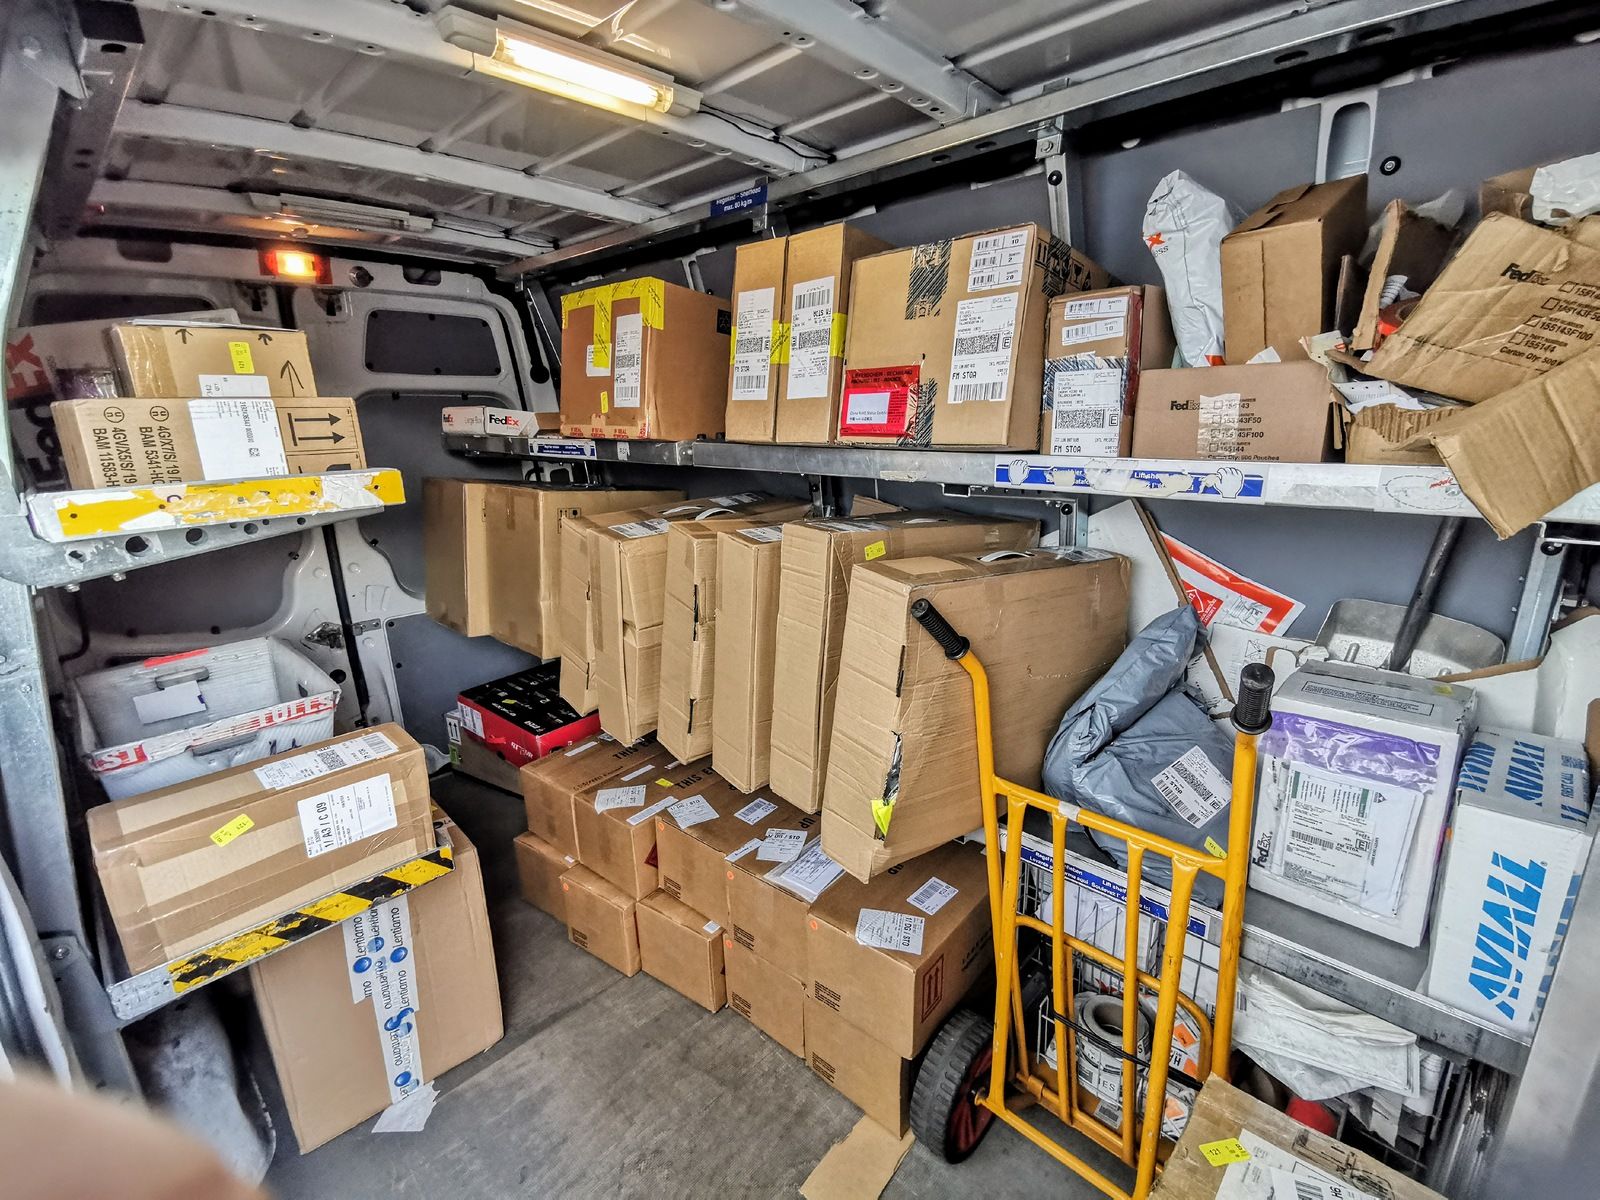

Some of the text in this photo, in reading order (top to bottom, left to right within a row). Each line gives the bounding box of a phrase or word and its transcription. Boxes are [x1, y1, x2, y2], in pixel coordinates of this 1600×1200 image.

[1501, 262, 1550, 286] FedEx
[952, 371, 977, 380] FM STOA
[489, 414, 519, 426] FedEx
[93, 428, 111, 450] BAM
[139, 427, 157, 448] BAM
[1053, 445, 1082, 453] FM STOA
[166, 464, 180, 474] 19
[123, 474, 138, 484] 19
[612, 746, 638, 760] THIS
[674, 774, 702, 790] THIS
[316, 802, 327, 813] 09
[1252, 832, 1272, 868] FedEx
[1102, 879, 1112, 887] Lift
[391, 907, 404, 948] Lentiamo
[353, 916, 367, 958] Lentiamo
[1468, 851, 1548, 1021] AVIALL
[398, 970, 410, 1009] Lentiamo
